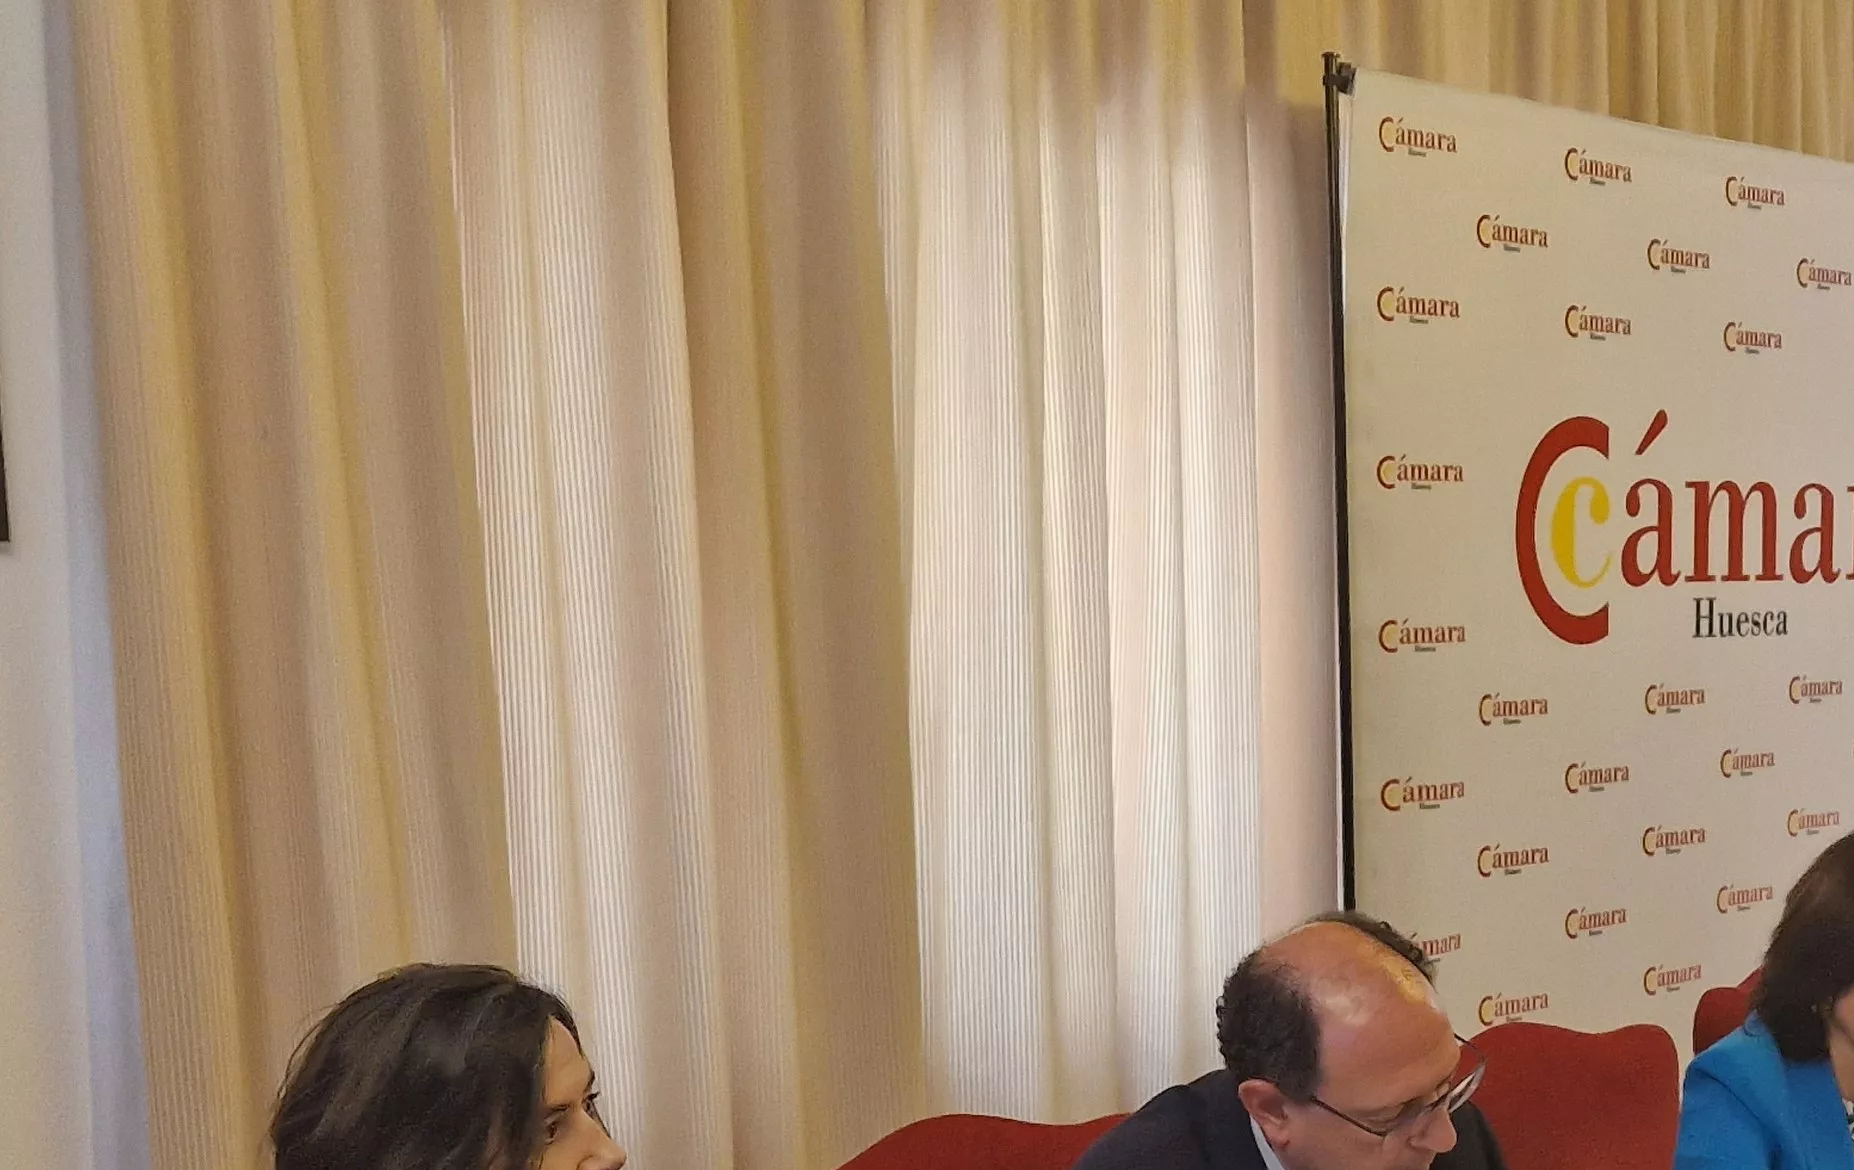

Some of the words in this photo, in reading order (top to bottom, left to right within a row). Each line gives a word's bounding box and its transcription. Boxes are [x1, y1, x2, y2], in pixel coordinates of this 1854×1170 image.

[1379, 116, 1457, 153] Cámara
[1564, 147, 1632, 184] Cámara
[1724, 176, 1785, 209] Cámara
[1476, 215, 1548, 251] Cámara
[1647, 239, 1710, 274] Cámara
[1796, 258, 1852, 289] Cámara
[1377, 286, 1460, 322] Cámara
[1565, 305, 1631, 340] Cámara
[1723, 322, 1782, 352] Cámara
[1376, 453, 1464, 490] Cámara
[1378, 618, 1466, 653] Cámara
[1692, 597, 1788, 639] Huesca
[1645, 683, 1705, 715] Cámara
[1789, 675, 1843, 704] Cámara
[1478, 692, 1548, 727] Cámara
[1565, 761, 1629, 796] Cámara
[1720, 748, 1775, 779] Cámara
[1380, 776, 1465, 812] Cámara
[1788, 808, 1840, 837] Cámara
[1640, 824, 1706, 857] Cámara
[1477, 843, 1549, 878] Cámara
[1717, 884, 1773, 914] Cámara
[1565, 906, 1627, 939] Cámara
[1643, 964, 1701, 996] Cámara
[1478, 993, 1549, 1026] Cámara
